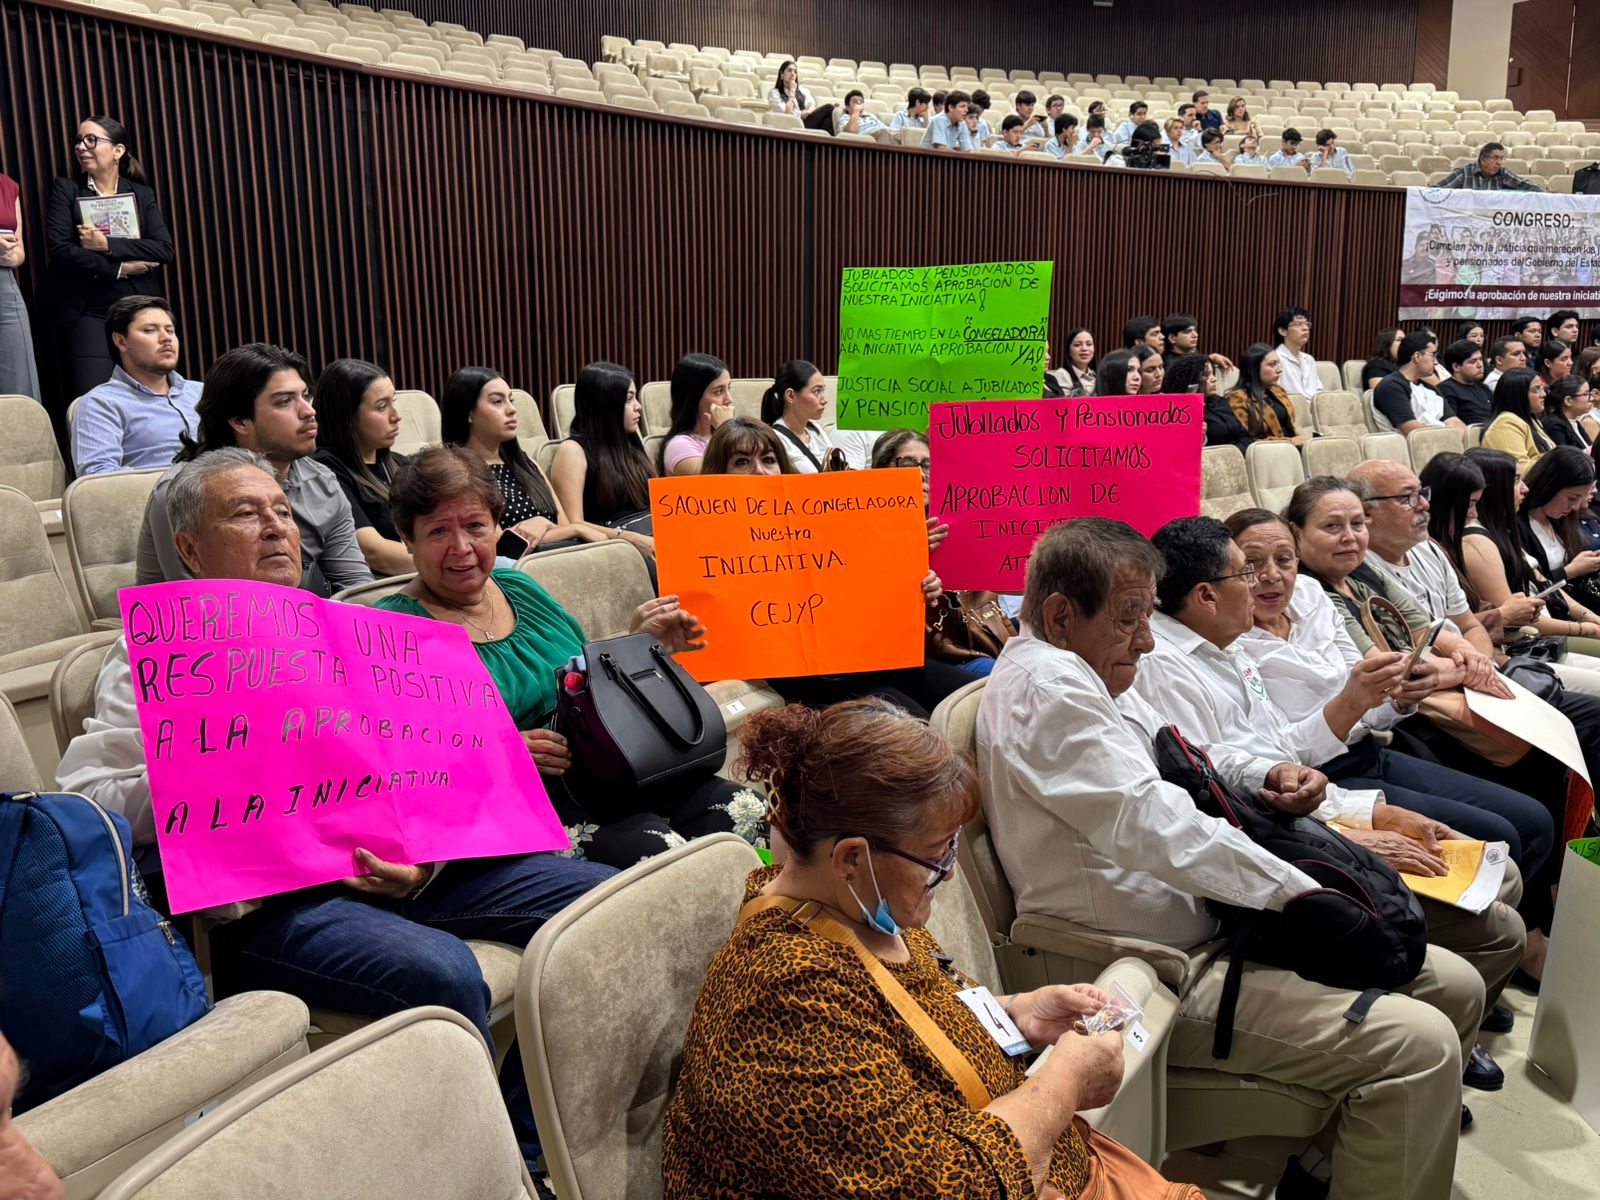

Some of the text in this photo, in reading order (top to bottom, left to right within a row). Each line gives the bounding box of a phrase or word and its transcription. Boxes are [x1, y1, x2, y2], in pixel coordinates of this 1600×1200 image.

[1492, 211, 1575, 229] CONGRESO:
[1527, 244, 1544, 255] que
[1545, 245, 1581, 254] merecen
[843, 268, 915, 281] JUBILADOS
[934, 262, 1036, 279] PENSIONADOS
[843, 276, 1040, 294] SOLICITAMOS APROBACION DE
[842, 294, 898, 307] NUESTRA
[1476, 289, 1526, 302] aprobación
[1527, 290, 1538, 300] de
[1540, 291, 1571, 300] nuestra
[1572, 290, 1600, 301] iniciati
[840, 327, 854, 341] NO
[856, 327, 882, 341] MAS
[883, 328, 927, 341] TIEMPO
[929, 327, 946, 340] EN
[947, 327, 961, 340] LA
[929, 341, 1015, 357] APROBACION
[837, 377, 1040, 395] JUSTICIA SOCIAL A JUBILADOS
[840, 398, 930, 419] Y PENSION
[932, 401, 1192, 440] Jubilados Y Pensionados
[1011, 443, 1152, 469] SOLICITAMOS
[658, 495, 919, 517] SAQUEN DE LA CONGELADORA
[939, 482, 1121, 515] APROBACION DE
[749, 525, 812, 542] Nuestra
[750, 593, 824, 627] CEJYP
[129, 592, 422, 666] QUEREMOS UNA
[371, 664, 498, 708] POSITIVA
[156, 707, 485, 760] A LA APROBACION
[164, 801, 189, 835] A
